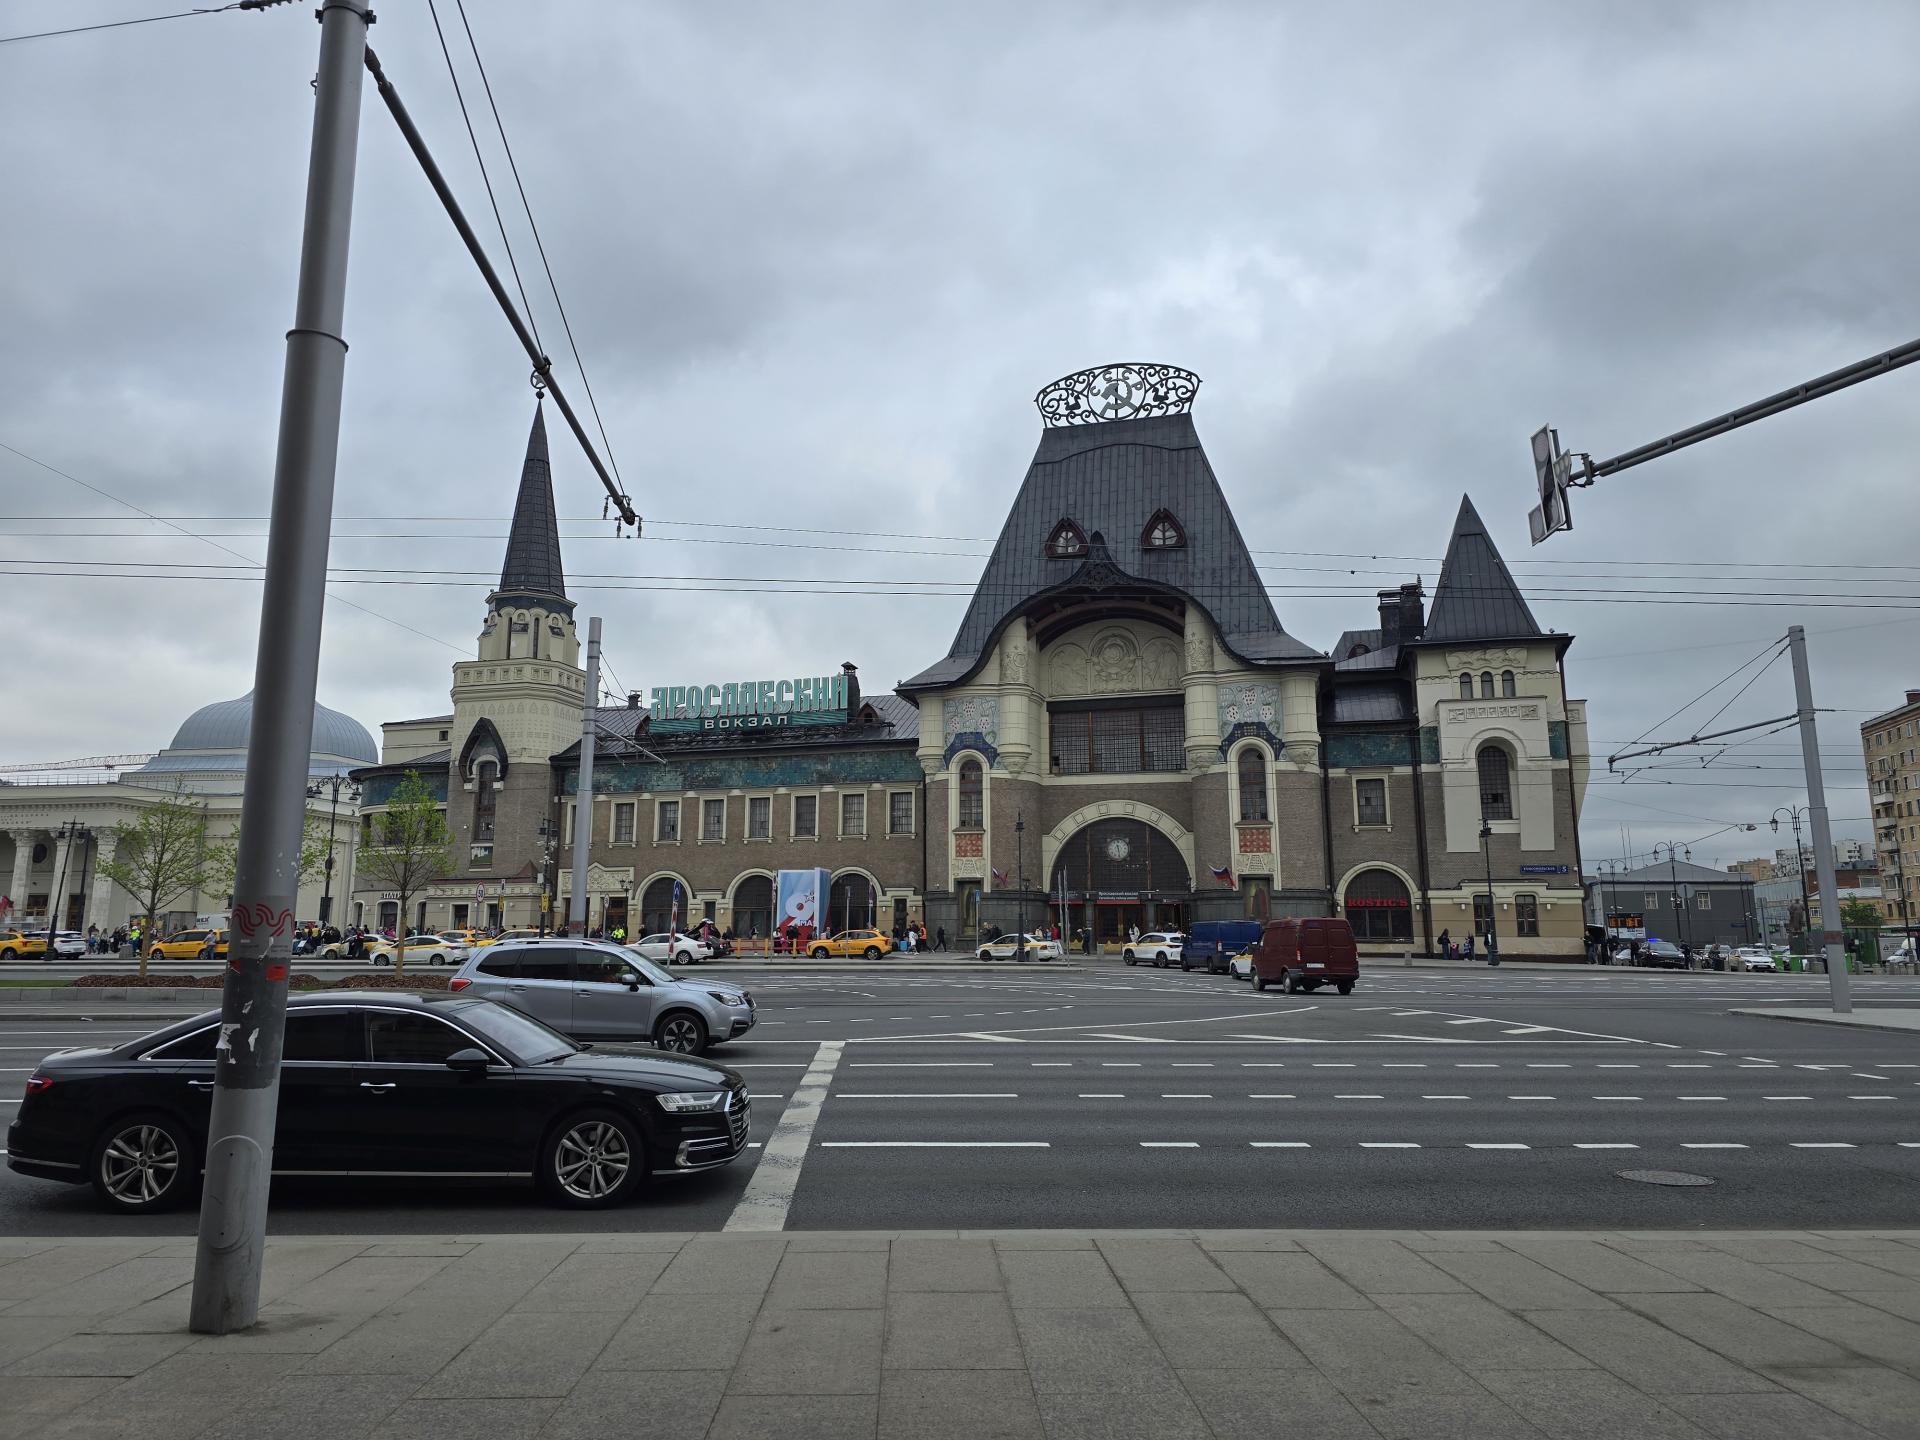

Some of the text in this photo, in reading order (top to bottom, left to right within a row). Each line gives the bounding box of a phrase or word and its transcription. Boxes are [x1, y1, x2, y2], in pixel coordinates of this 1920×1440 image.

[1089, 369, 1144, 397] СССР
[650, 674, 848, 720] ЯРОСЛАВСКИЙ
[704, 715, 788, 729] ВОКЗАЛ
[800, 919, 814, 927] МА
